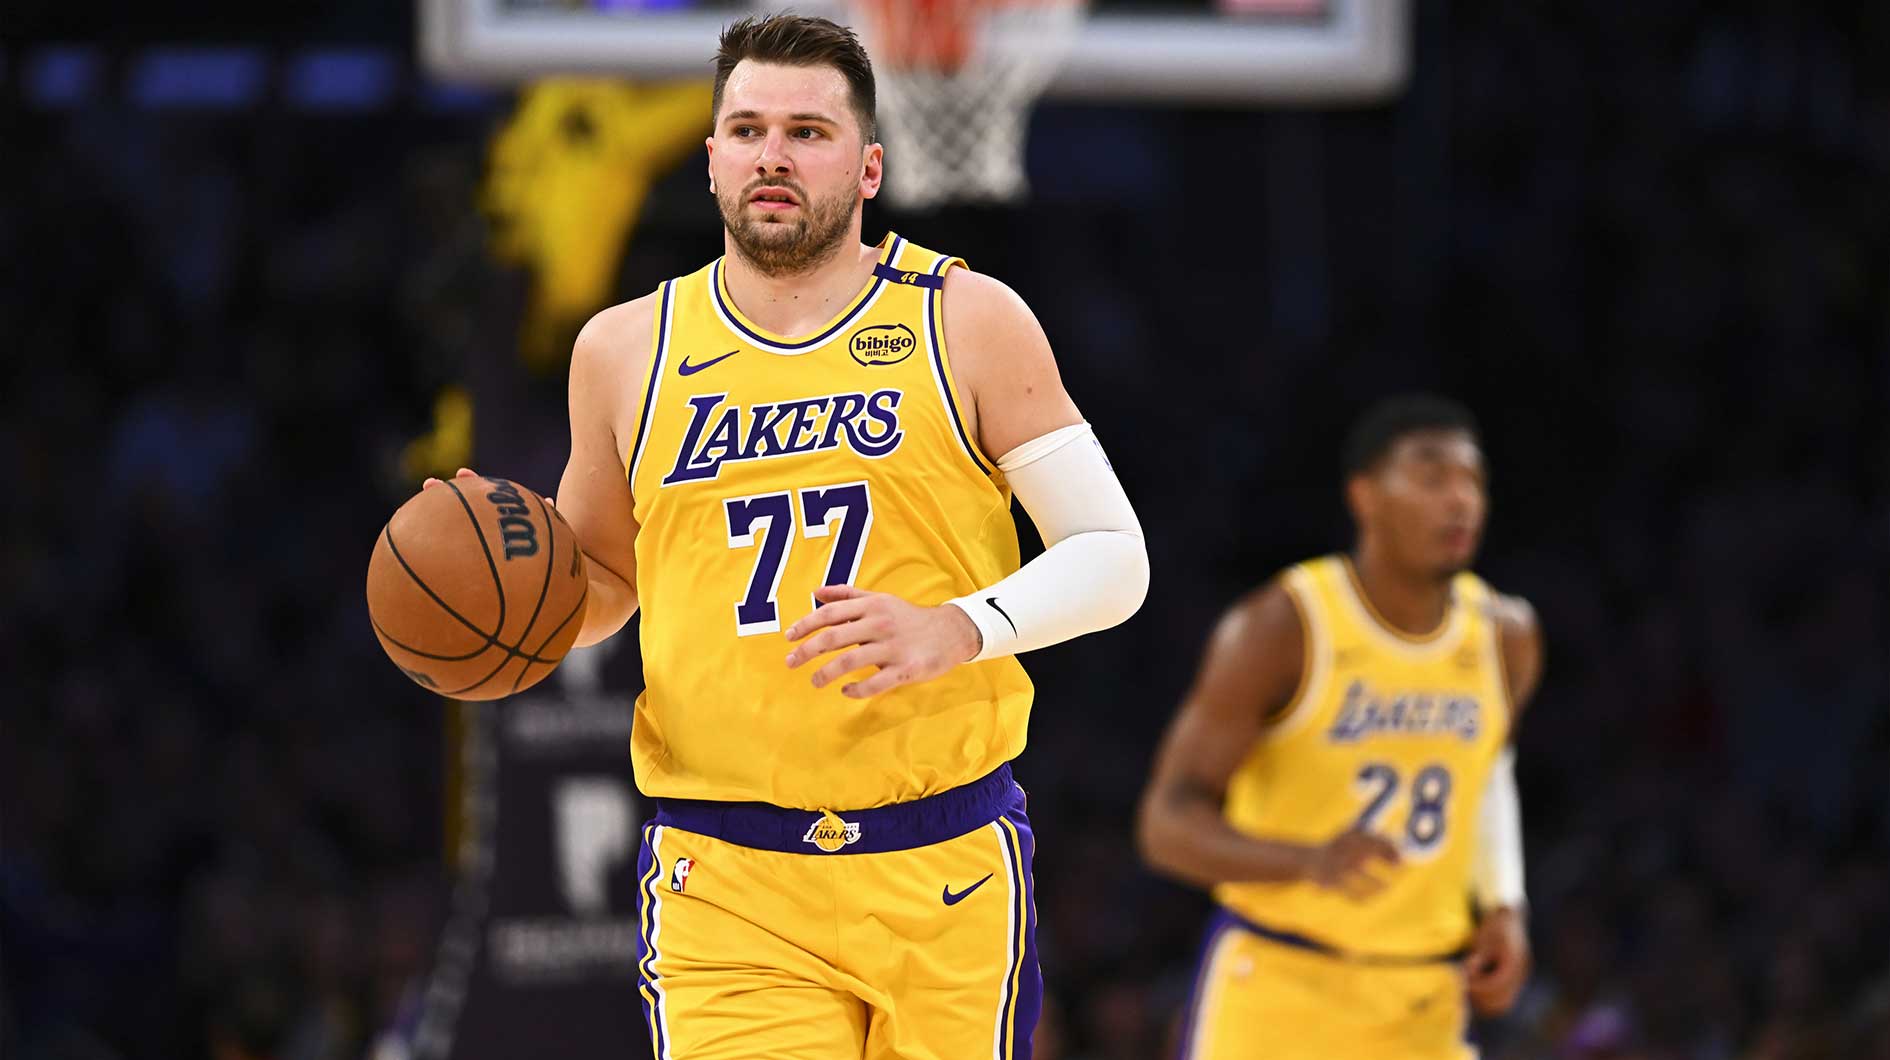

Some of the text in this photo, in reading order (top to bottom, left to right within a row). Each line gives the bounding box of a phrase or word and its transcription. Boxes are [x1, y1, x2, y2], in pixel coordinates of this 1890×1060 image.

[901, 272, 919, 283] 44
[856, 335, 912, 353] bibigo
[660, 389, 905, 488] LAKERS
[722, 480, 874, 637] 77
[1351, 762, 1454, 858] 28
